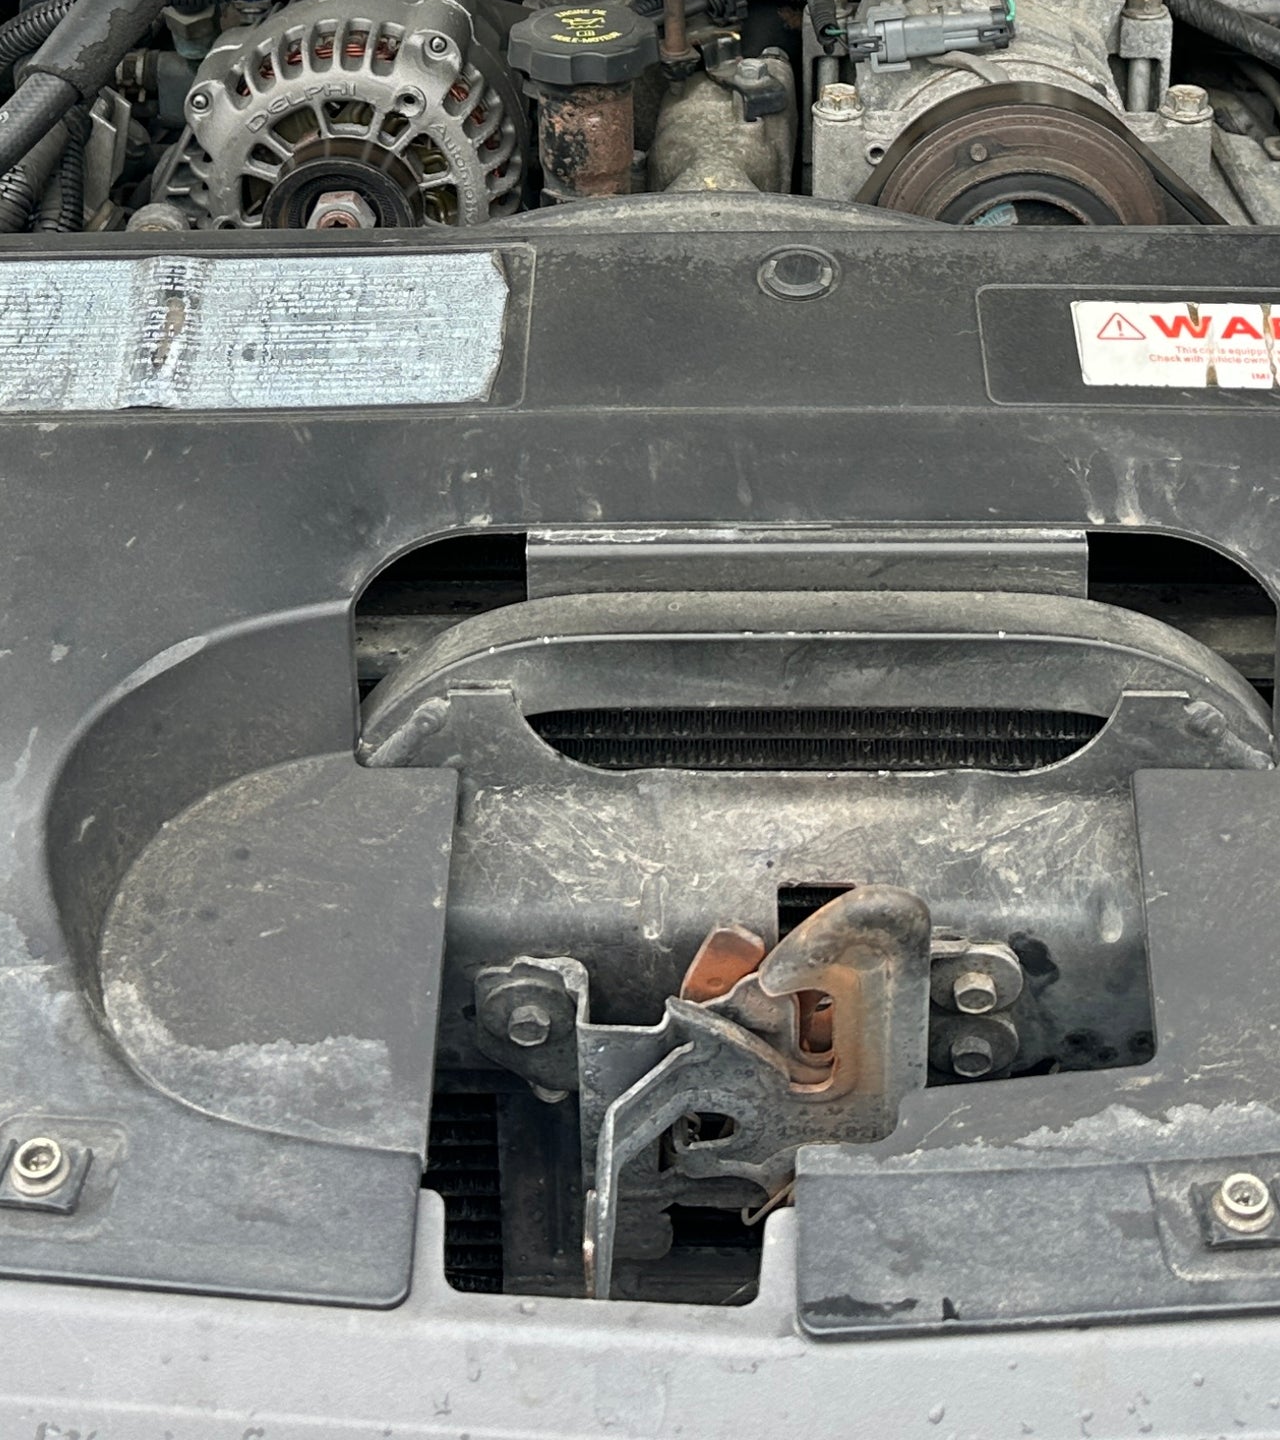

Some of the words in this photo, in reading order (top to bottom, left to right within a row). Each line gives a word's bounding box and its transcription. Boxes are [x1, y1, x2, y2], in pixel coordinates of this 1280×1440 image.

[246, 82, 359, 134] DELPHI
[1176, 346, 1197, 355] This
[1149, 354, 1181, 363] Check
[1184, 354, 1204, 363] with
